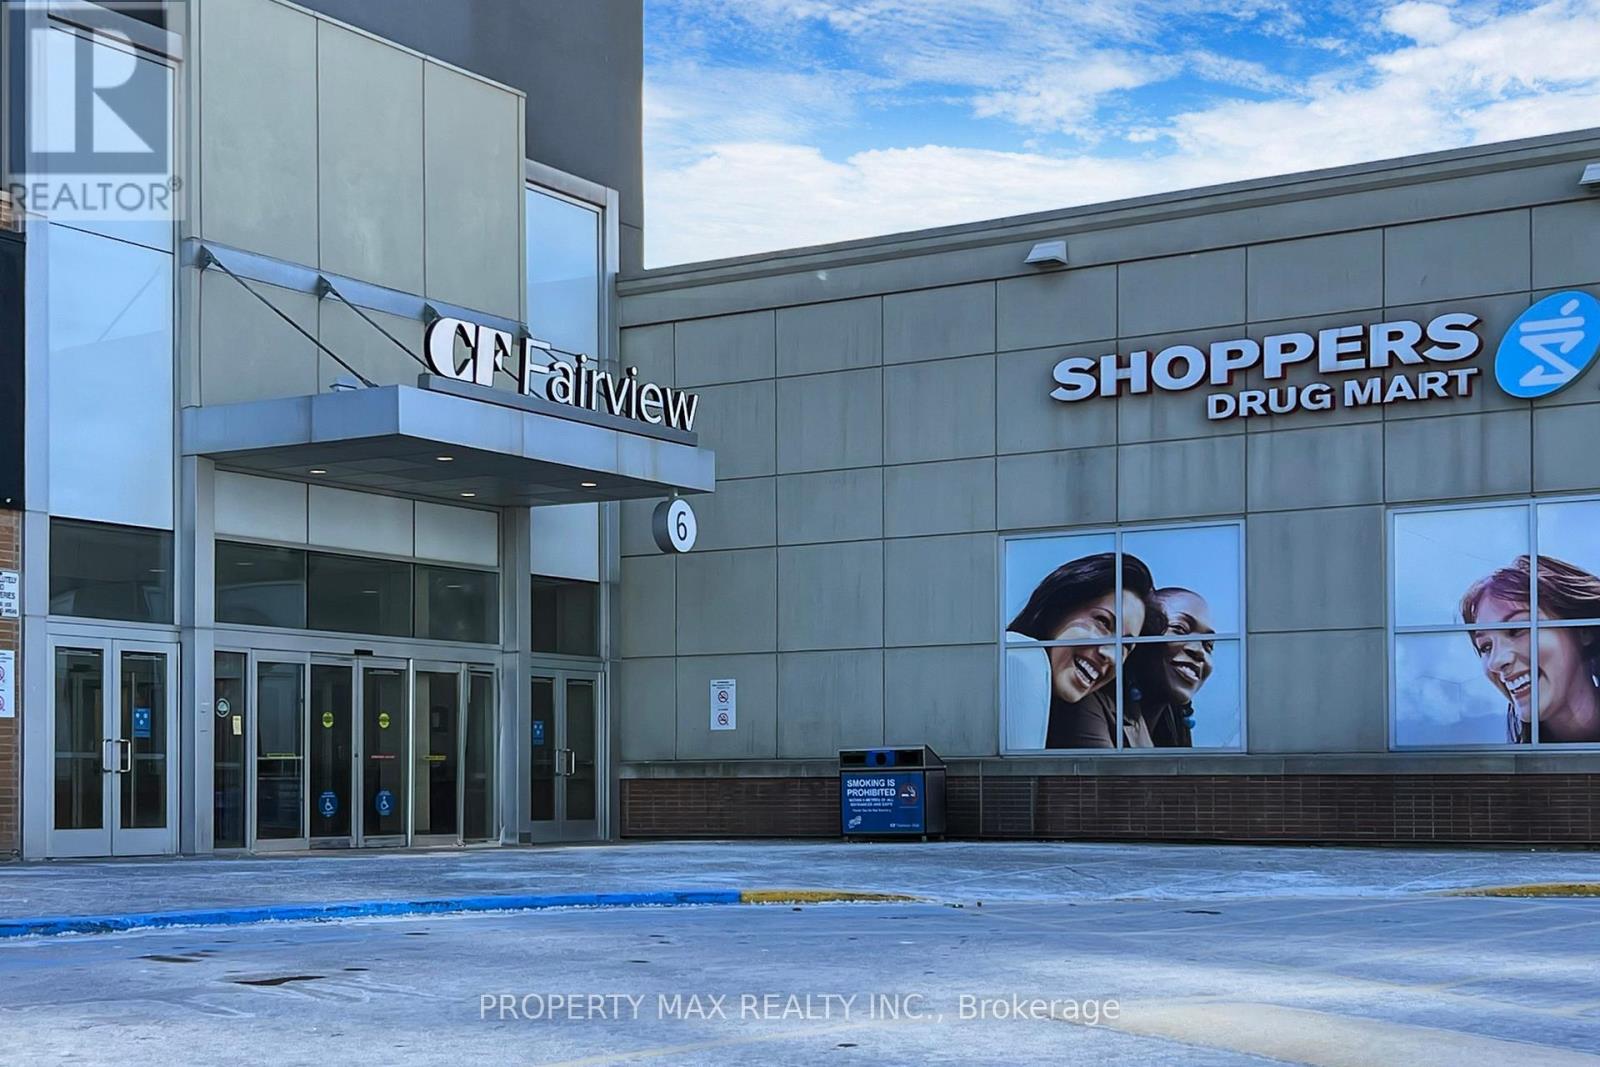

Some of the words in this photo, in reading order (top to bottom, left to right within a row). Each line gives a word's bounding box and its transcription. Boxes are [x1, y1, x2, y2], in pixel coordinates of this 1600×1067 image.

[424, 317, 512, 387] CF
[519, 336, 699, 432] Fairview
[1049, 312, 1481, 402] SHOPPERS
[1207, 383, 1333, 420] DRUG
[1343, 366, 1480, 408] MART
[676, 510, 687, 541] 6
[847, 779, 885, 788] SMOKING
[887, 779, 896, 787] IS
[847, 788, 896, 797] PROHIBITED
